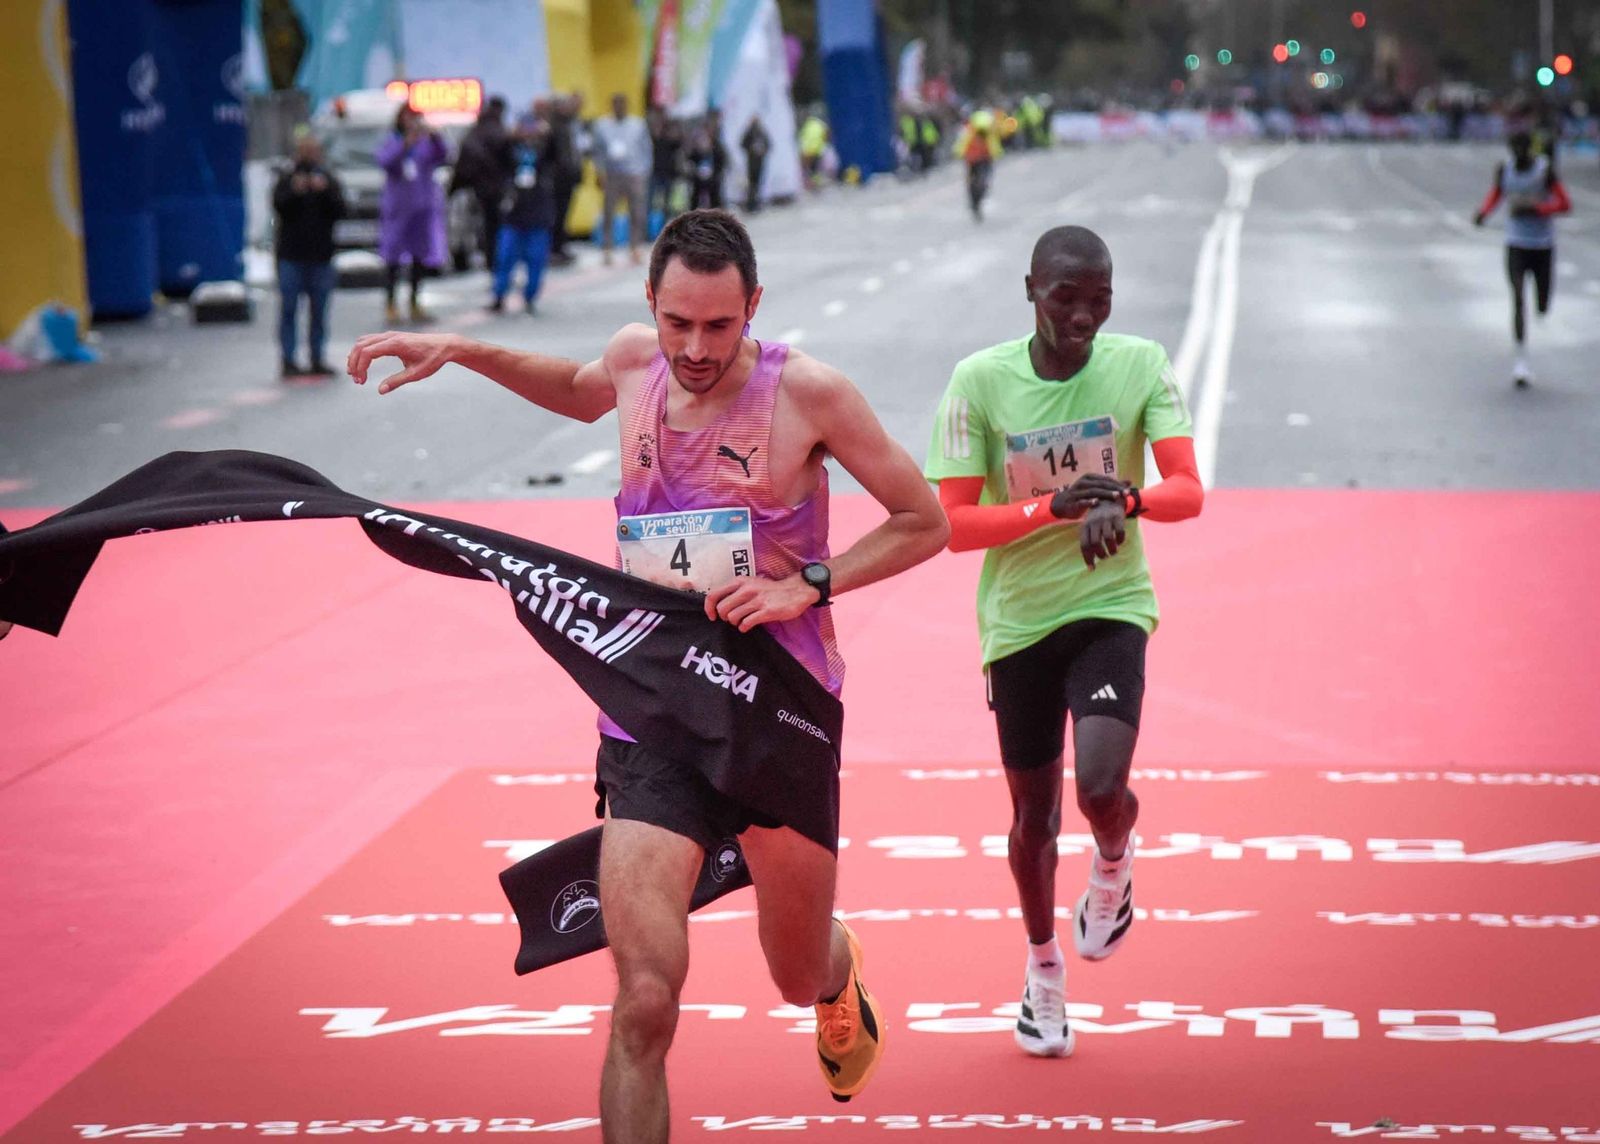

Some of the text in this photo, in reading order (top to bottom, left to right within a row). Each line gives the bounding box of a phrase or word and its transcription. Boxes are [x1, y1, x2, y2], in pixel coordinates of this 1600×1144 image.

[1043, 443, 1078, 476] 14
[655, 514, 703, 527] maratón
[666, 521, 704, 534] sevilla
[670, 538, 691, 576] 4
[680, 645, 759, 703] HOKA
